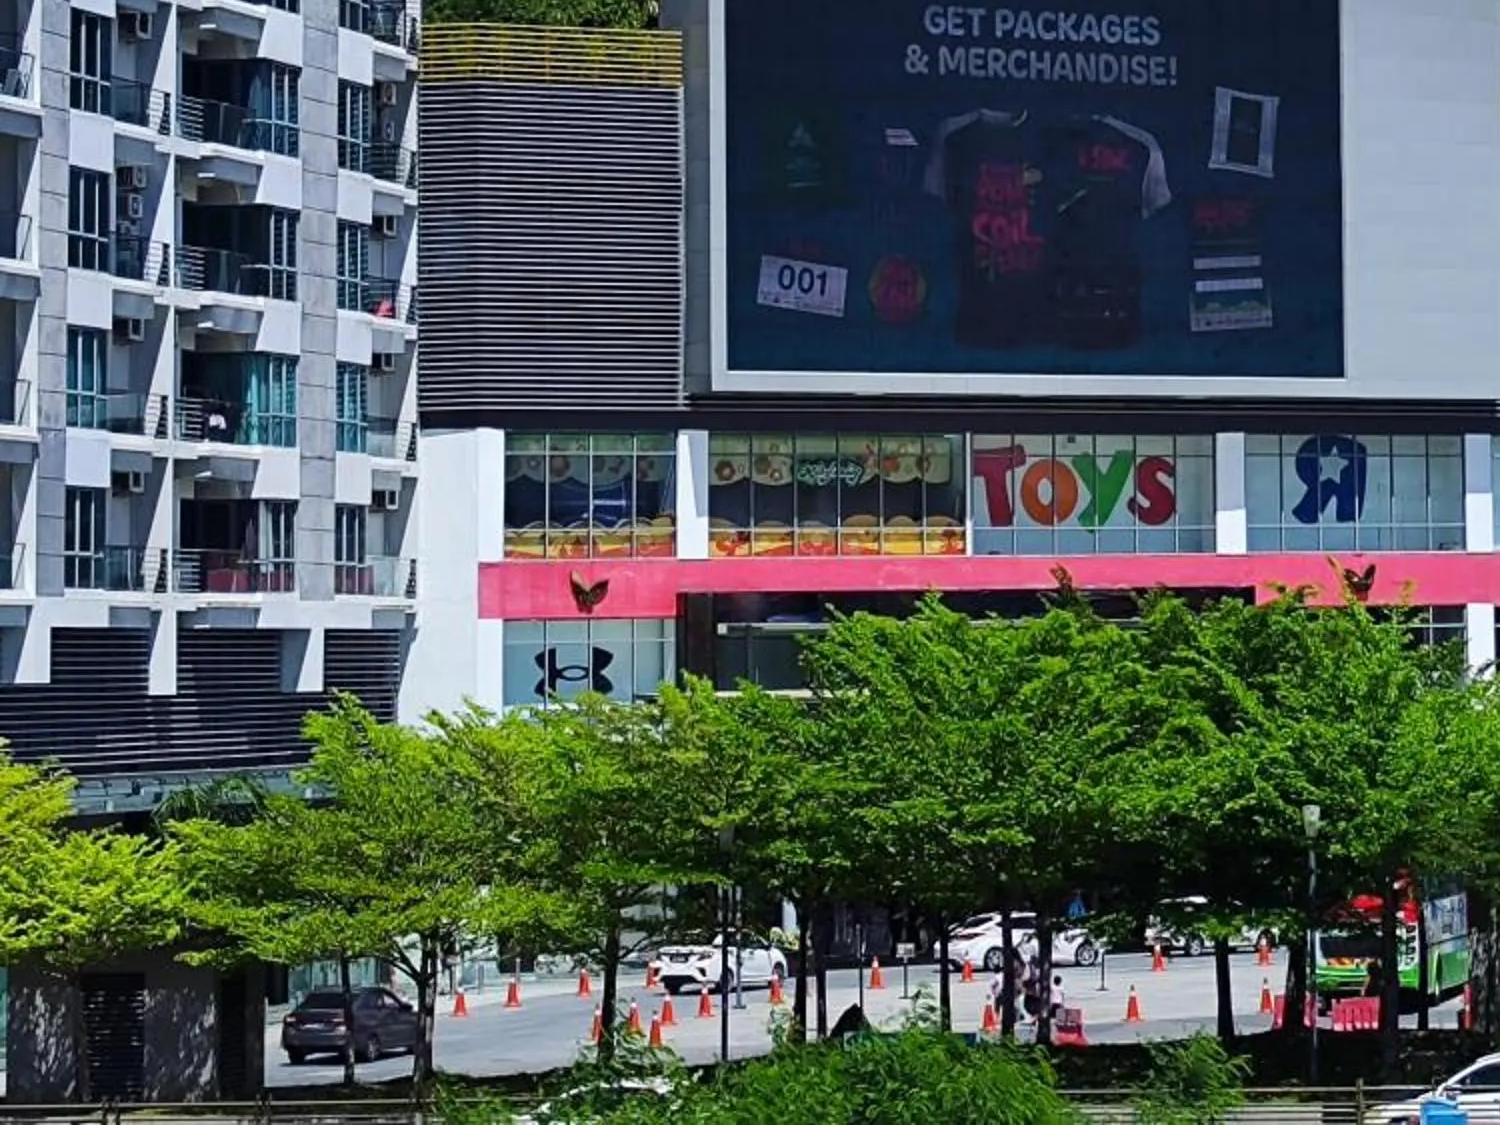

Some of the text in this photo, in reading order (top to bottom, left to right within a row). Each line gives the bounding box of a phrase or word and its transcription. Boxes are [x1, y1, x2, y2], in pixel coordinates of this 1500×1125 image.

[923, 5, 1161, 46] GET PACKAGES
[904, 44, 1178, 86] & MERCHANDISE!
[777, 264, 828, 297] 001
